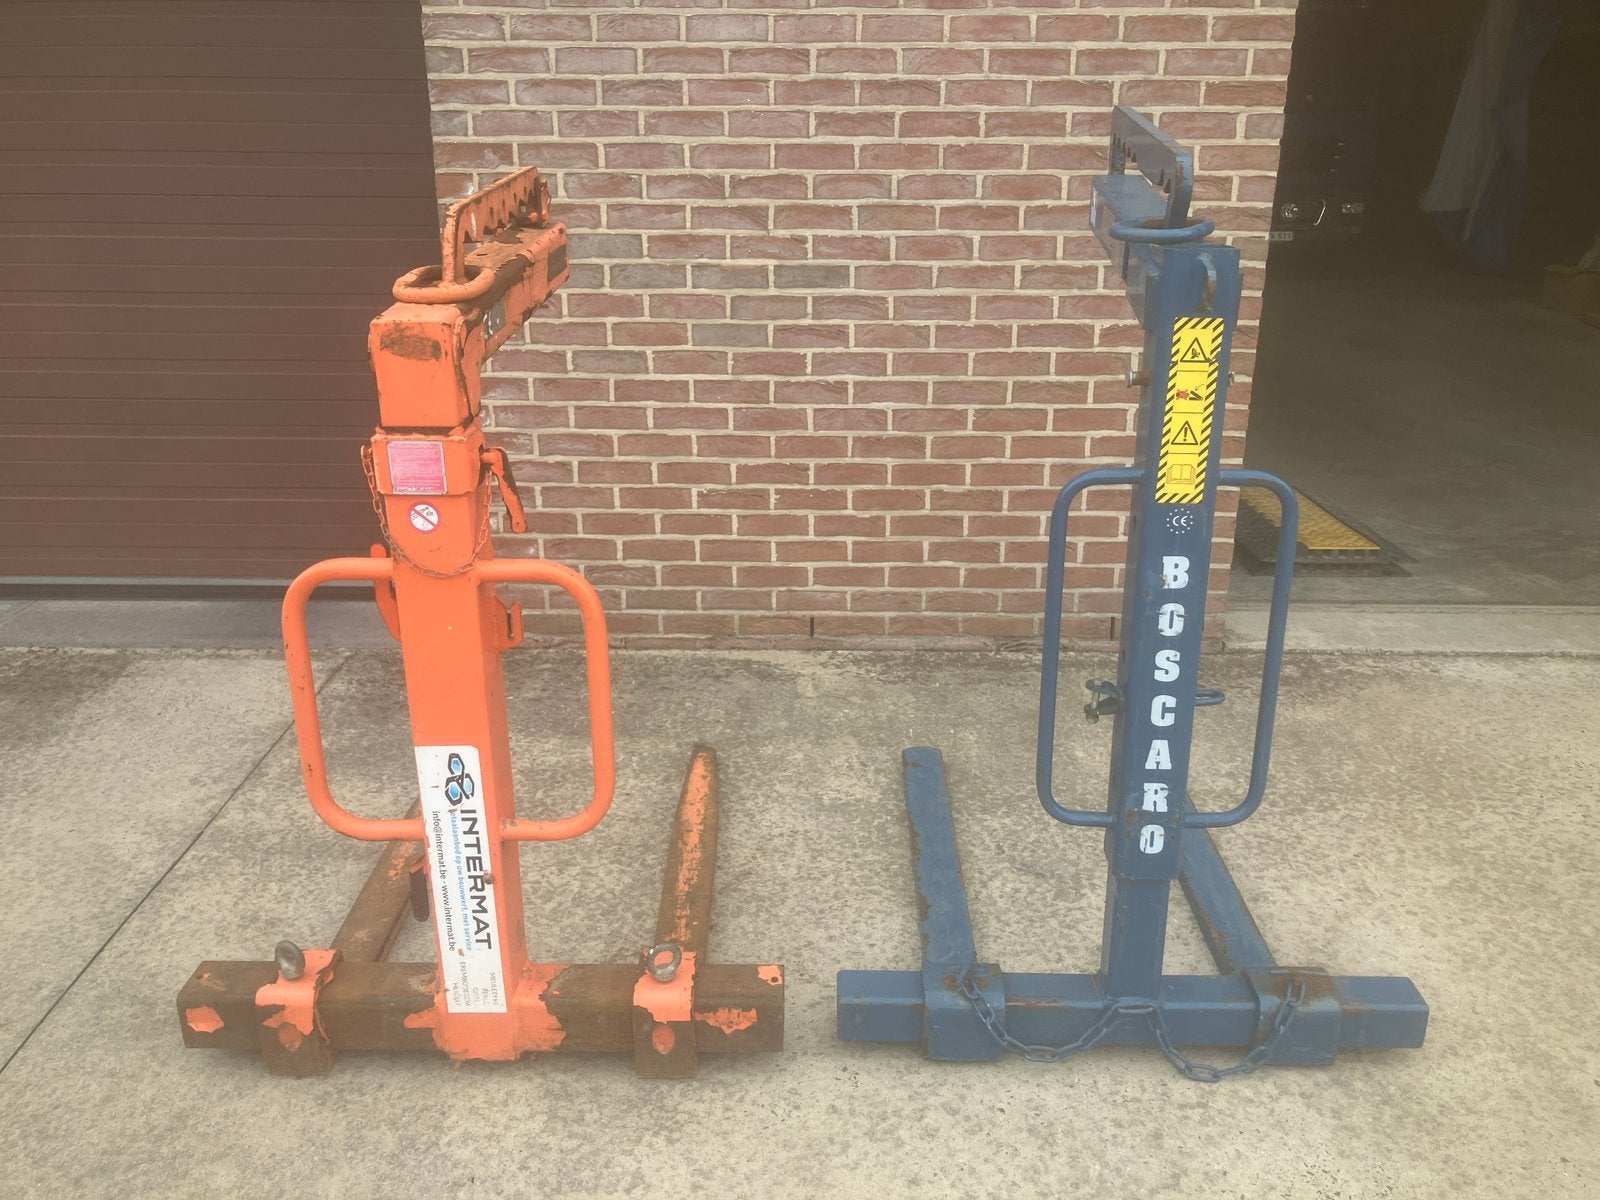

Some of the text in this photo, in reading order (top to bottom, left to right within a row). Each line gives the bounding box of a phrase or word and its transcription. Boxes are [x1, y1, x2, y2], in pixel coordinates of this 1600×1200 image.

[1139, 556, 1190, 854] BOSCARO
[432, 810, 448, 880] info@intermat.be
[441, 885, 457, 952] www.intermat.be
[449, 808, 463, 855] otaalaanbod
[464, 927, 472, 951] service
[460, 809, 492, 950] INTERMAT
